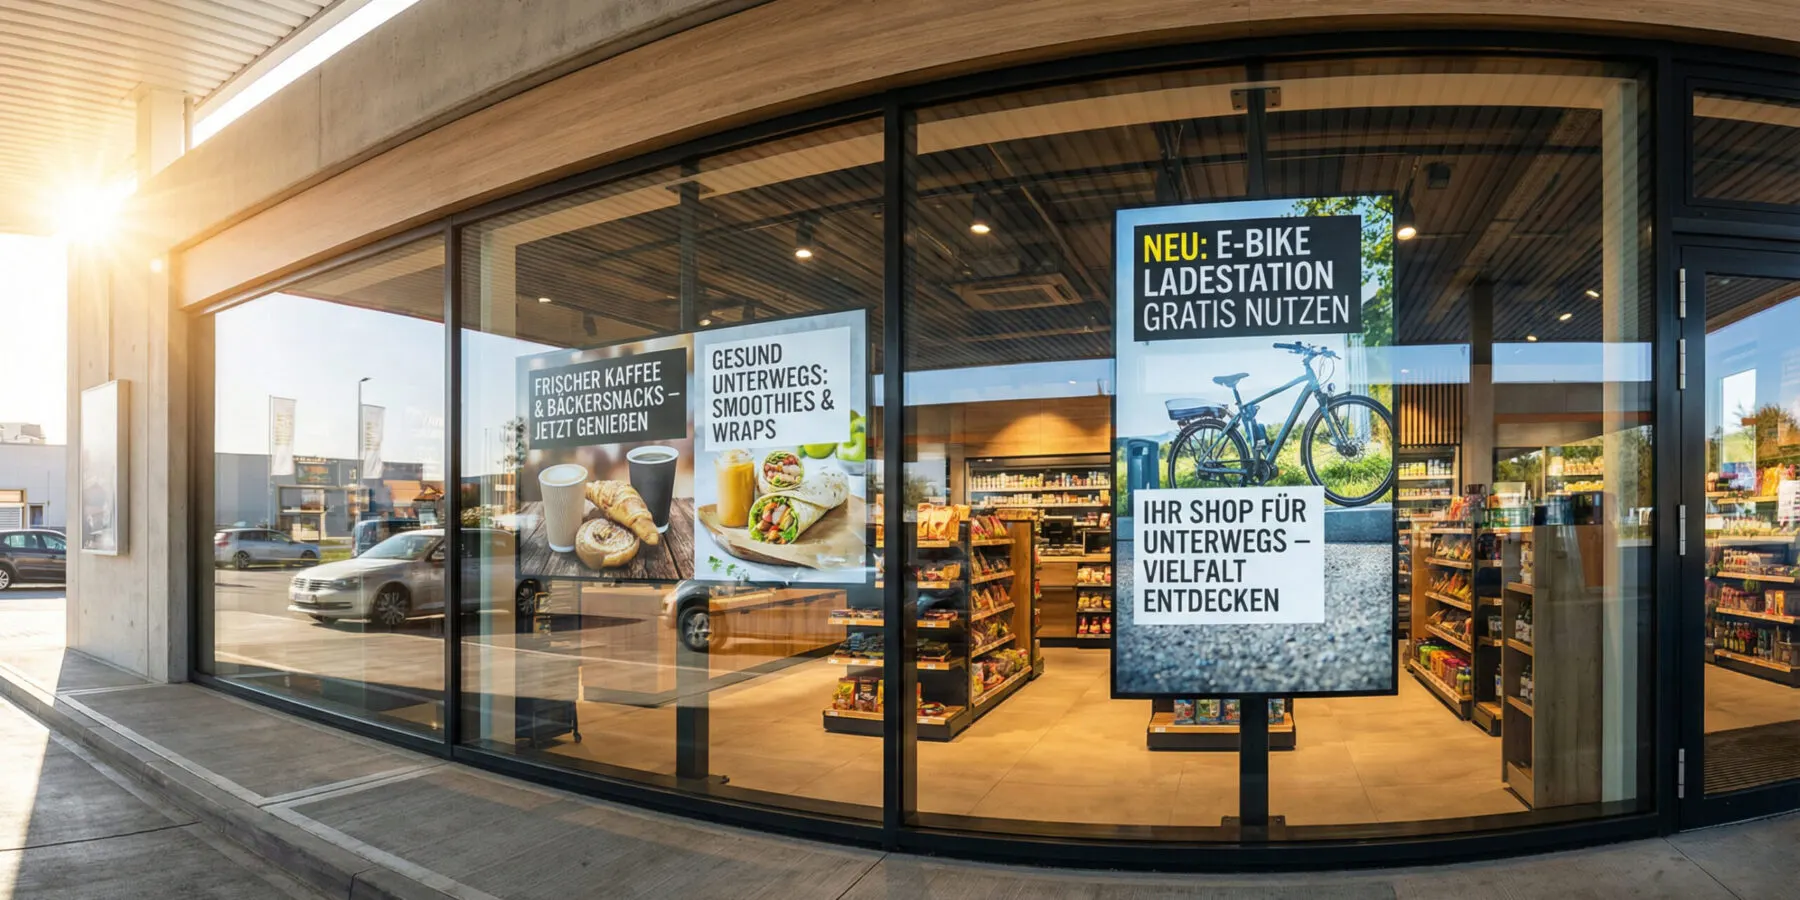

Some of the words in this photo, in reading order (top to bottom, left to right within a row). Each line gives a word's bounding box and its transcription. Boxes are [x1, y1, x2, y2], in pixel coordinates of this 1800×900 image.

[1144, 231, 1208, 263] NEU:
[1217, 226, 1311, 259] E-BIKE
[1144, 260, 1334, 297] LADESTATION
[1143, 299, 1236, 331] GRATIS
[1246, 295, 1349, 327] NUTZEN
[712, 343, 782, 370] GESUND
[535, 370, 600, 396] FRISCHER
[605, 361, 662, 387] KAFFEE
[713, 364, 828, 394] UNTERWEGS:
[535, 400, 544, 418] &
[547, 385, 664, 417] BÄCKERSNACKS
[712, 390, 815, 418] SMOOTHIES
[821, 389, 835, 411] &
[535, 419, 573, 440] JETZT
[577, 411, 648, 437] GENIEßEN
[712, 419, 776, 443] WRAPS
[1144, 500, 1182, 524] IHR
[1190, 499, 1254, 524] SHOP
[1262, 493, 1306, 523] FÜR
[1143, 528, 1287, 554] UNTERWEGS
[1143, 559, 1247, 583] VIELFALT
[1144, 588, 1279, 612] ENTDECKEN
